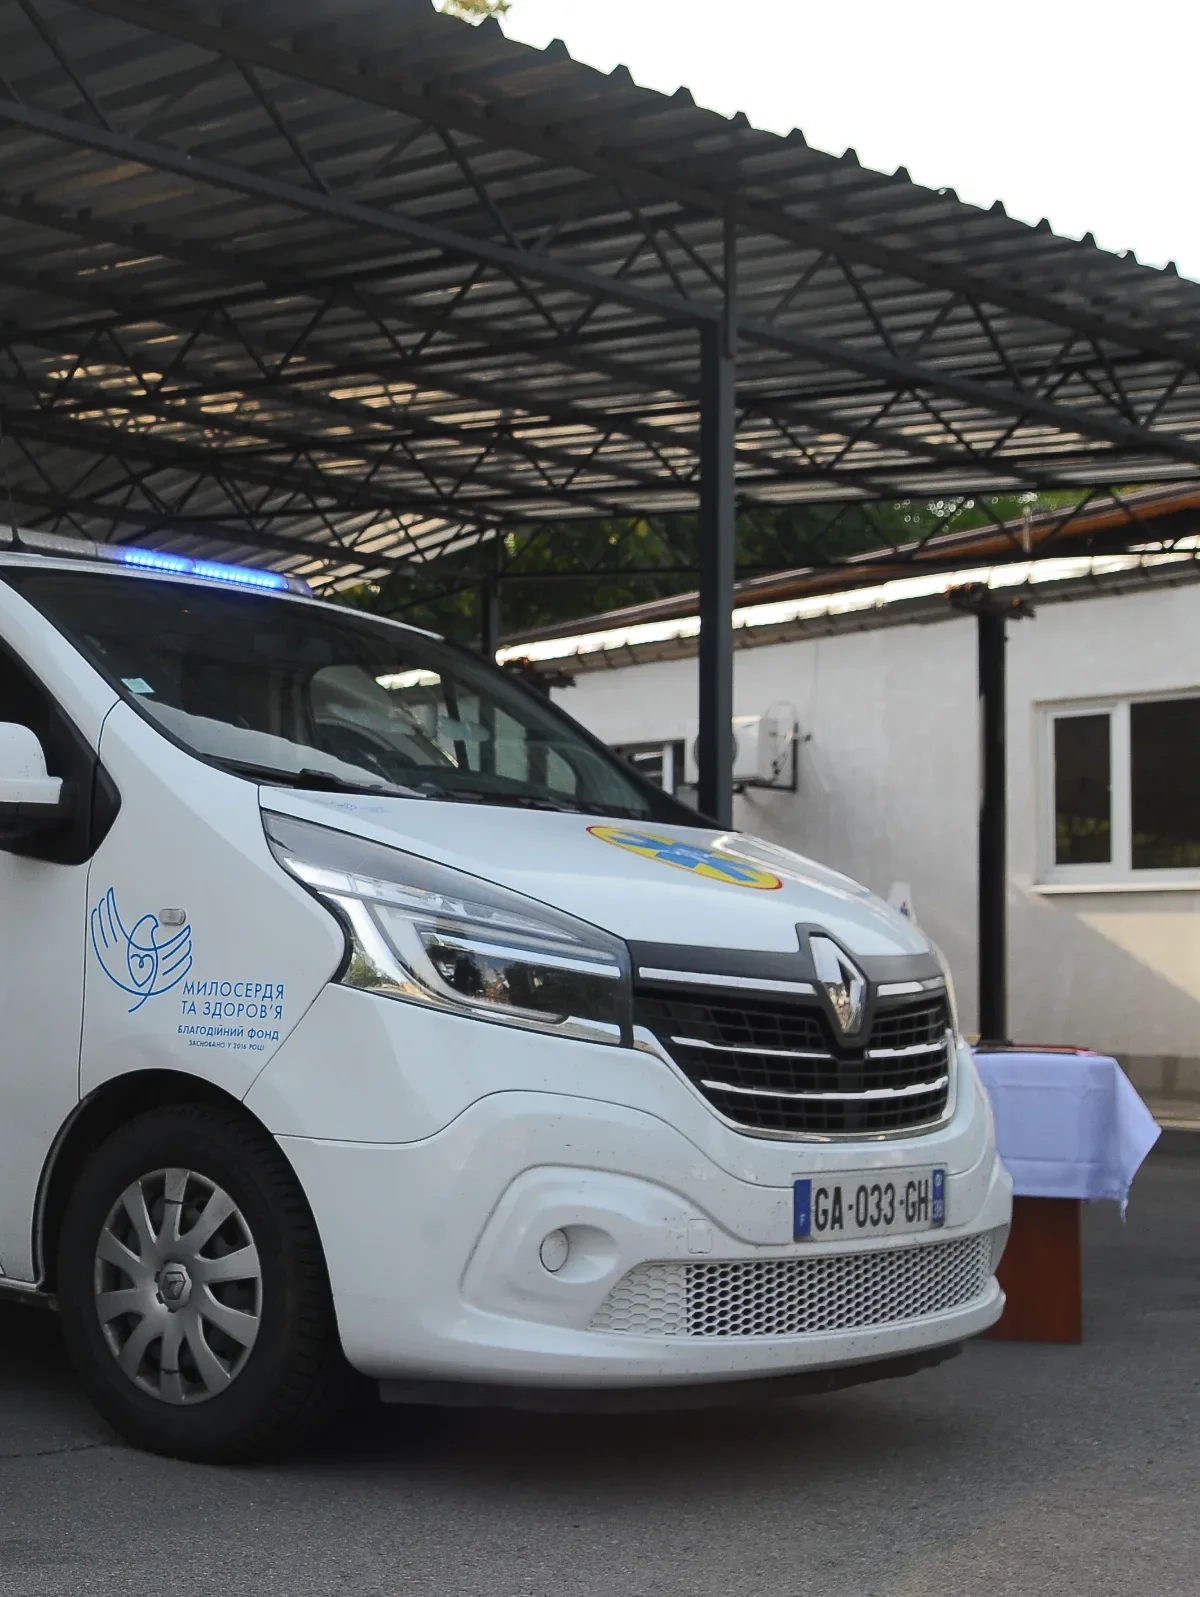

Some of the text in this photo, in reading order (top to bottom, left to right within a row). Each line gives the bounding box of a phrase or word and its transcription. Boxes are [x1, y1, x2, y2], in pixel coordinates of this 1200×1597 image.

[182, 981, 284, 1001] МИЛОСЕРДЯ
[181, 1000, 283, 1020] ТА ЗДОРОВ'Я
[177, 1024, 279, 1040] БЛАГОДІЙНИЙ ФОНД
